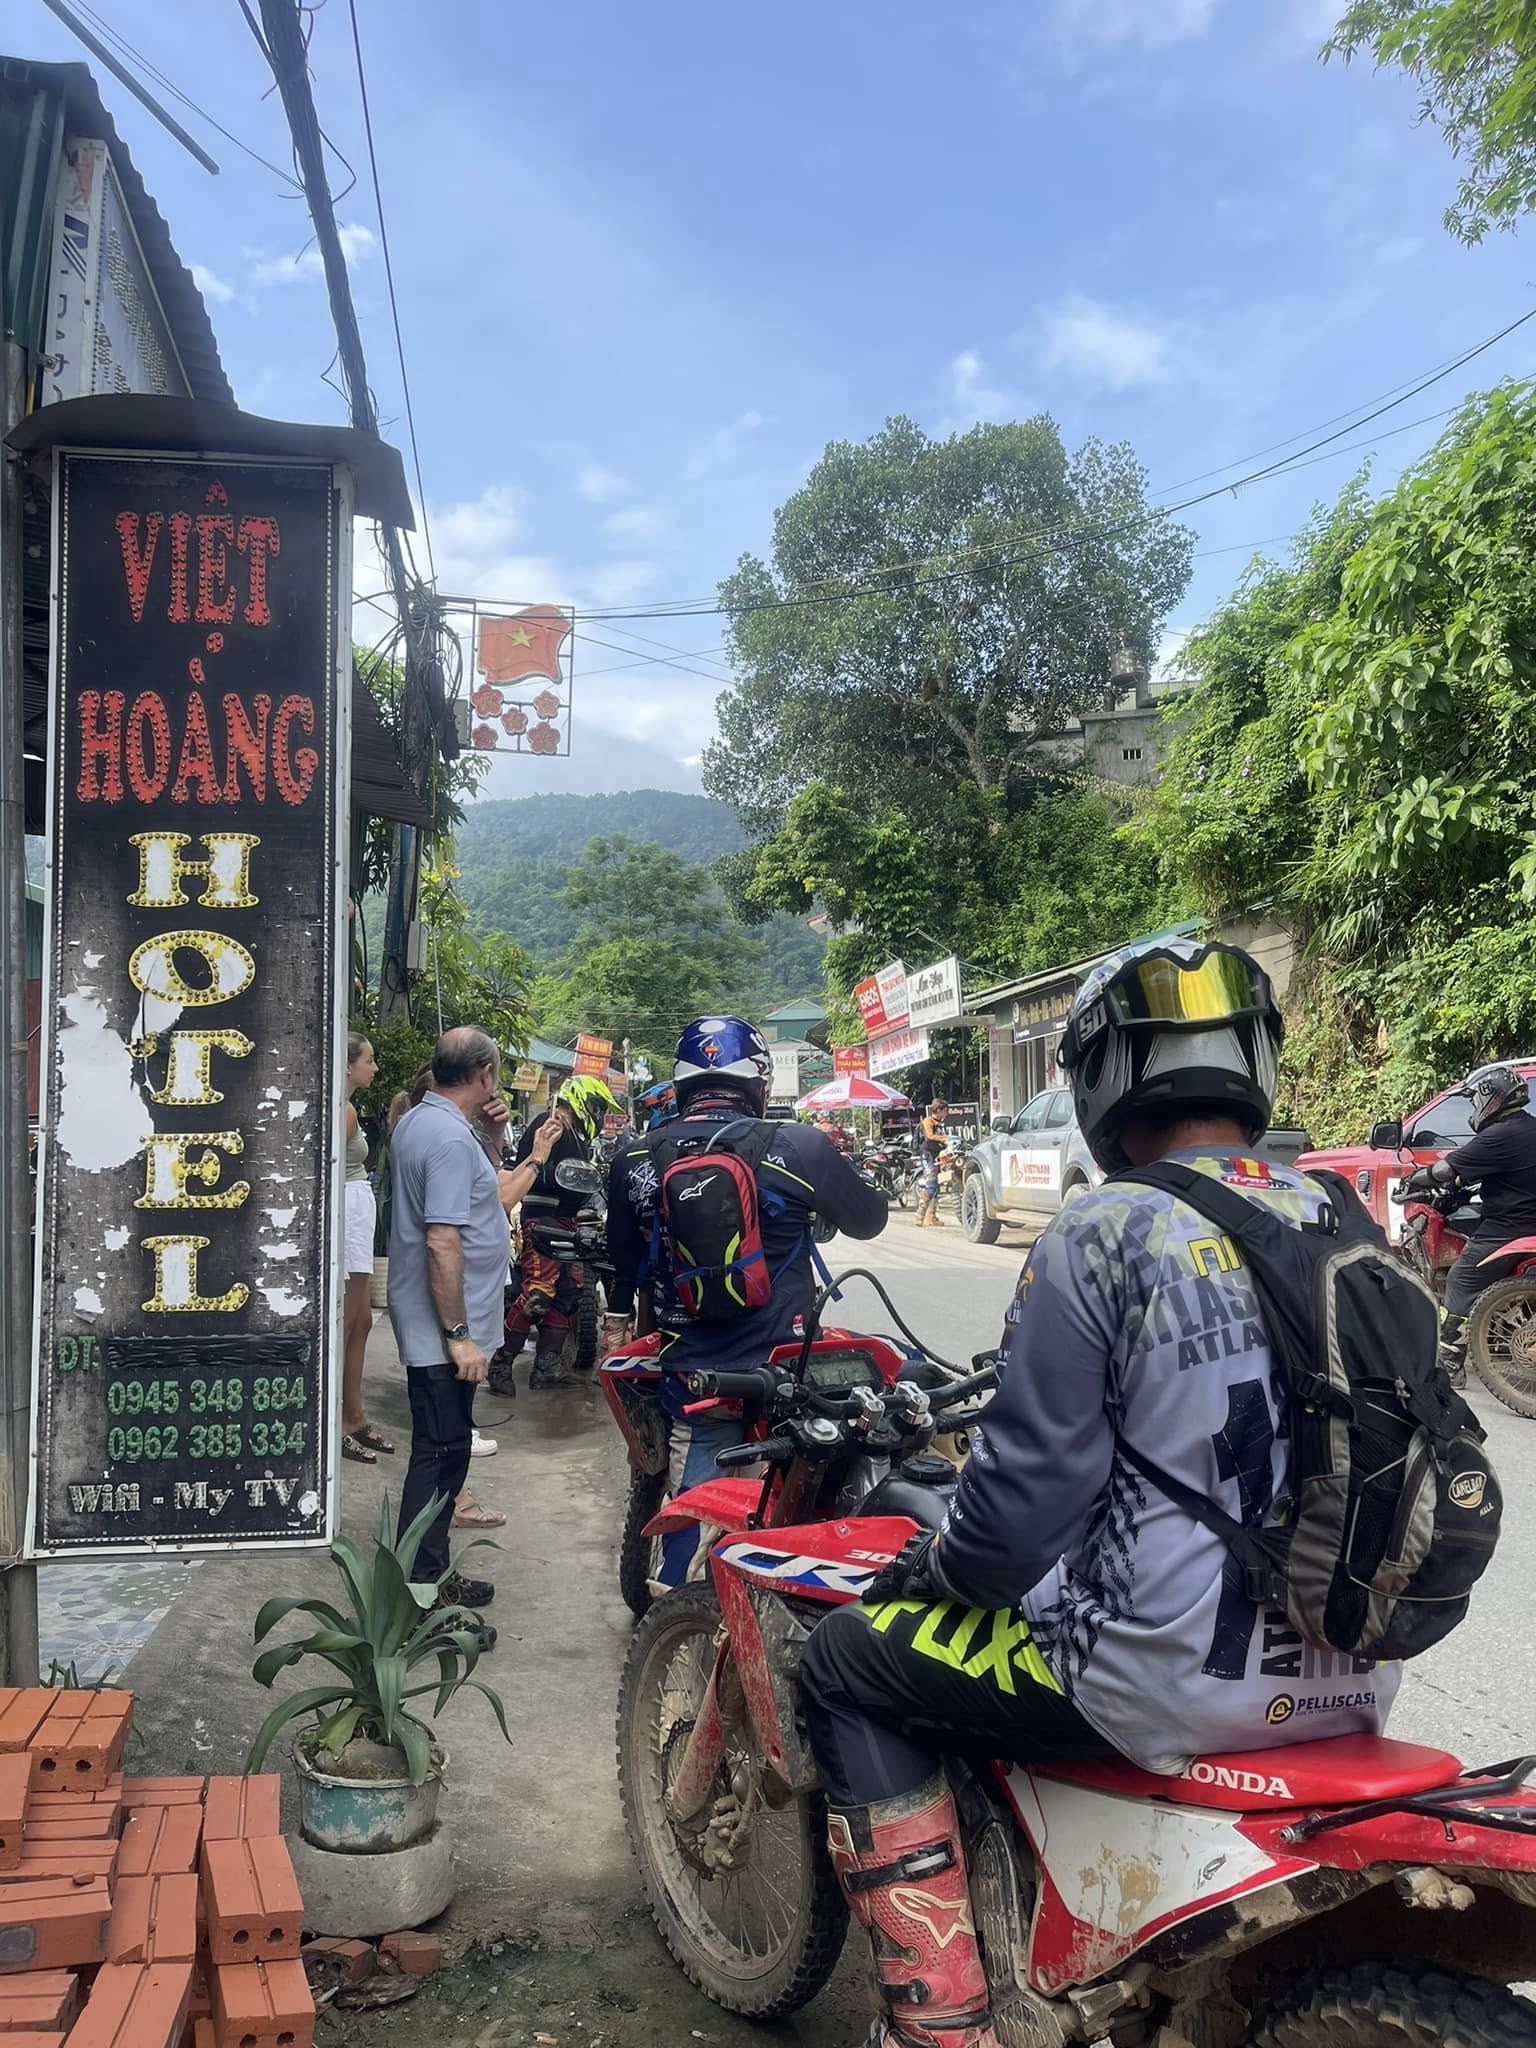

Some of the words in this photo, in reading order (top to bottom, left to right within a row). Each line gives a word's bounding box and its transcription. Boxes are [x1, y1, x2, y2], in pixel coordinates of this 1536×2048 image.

[114, 480, 281, 654] VIỆT
[75, 657, 320, 806] HOÀNG
[860, 986, 880, 1009] ENEOS
[126, 831, 262, 1313] HOTEL
[1023, 1163, 1050, 1174] VIETNAM
[106, 1379, 180, 1416] 0945
[189, 1378, 243, 1412] 348
[252, 1376, 308, 1412] 884
[106, 1425, 180, 1461] 0962
[189, 1424, 242, 1458] 385
[250, 1421, 308, 1457] 334
[68, 1482, 141, 1513] Wifi
[174, 1481, 234, 1517] My
[244, 1478, 300, 1508] TV
[843, 1548, 898, 1564] 30
